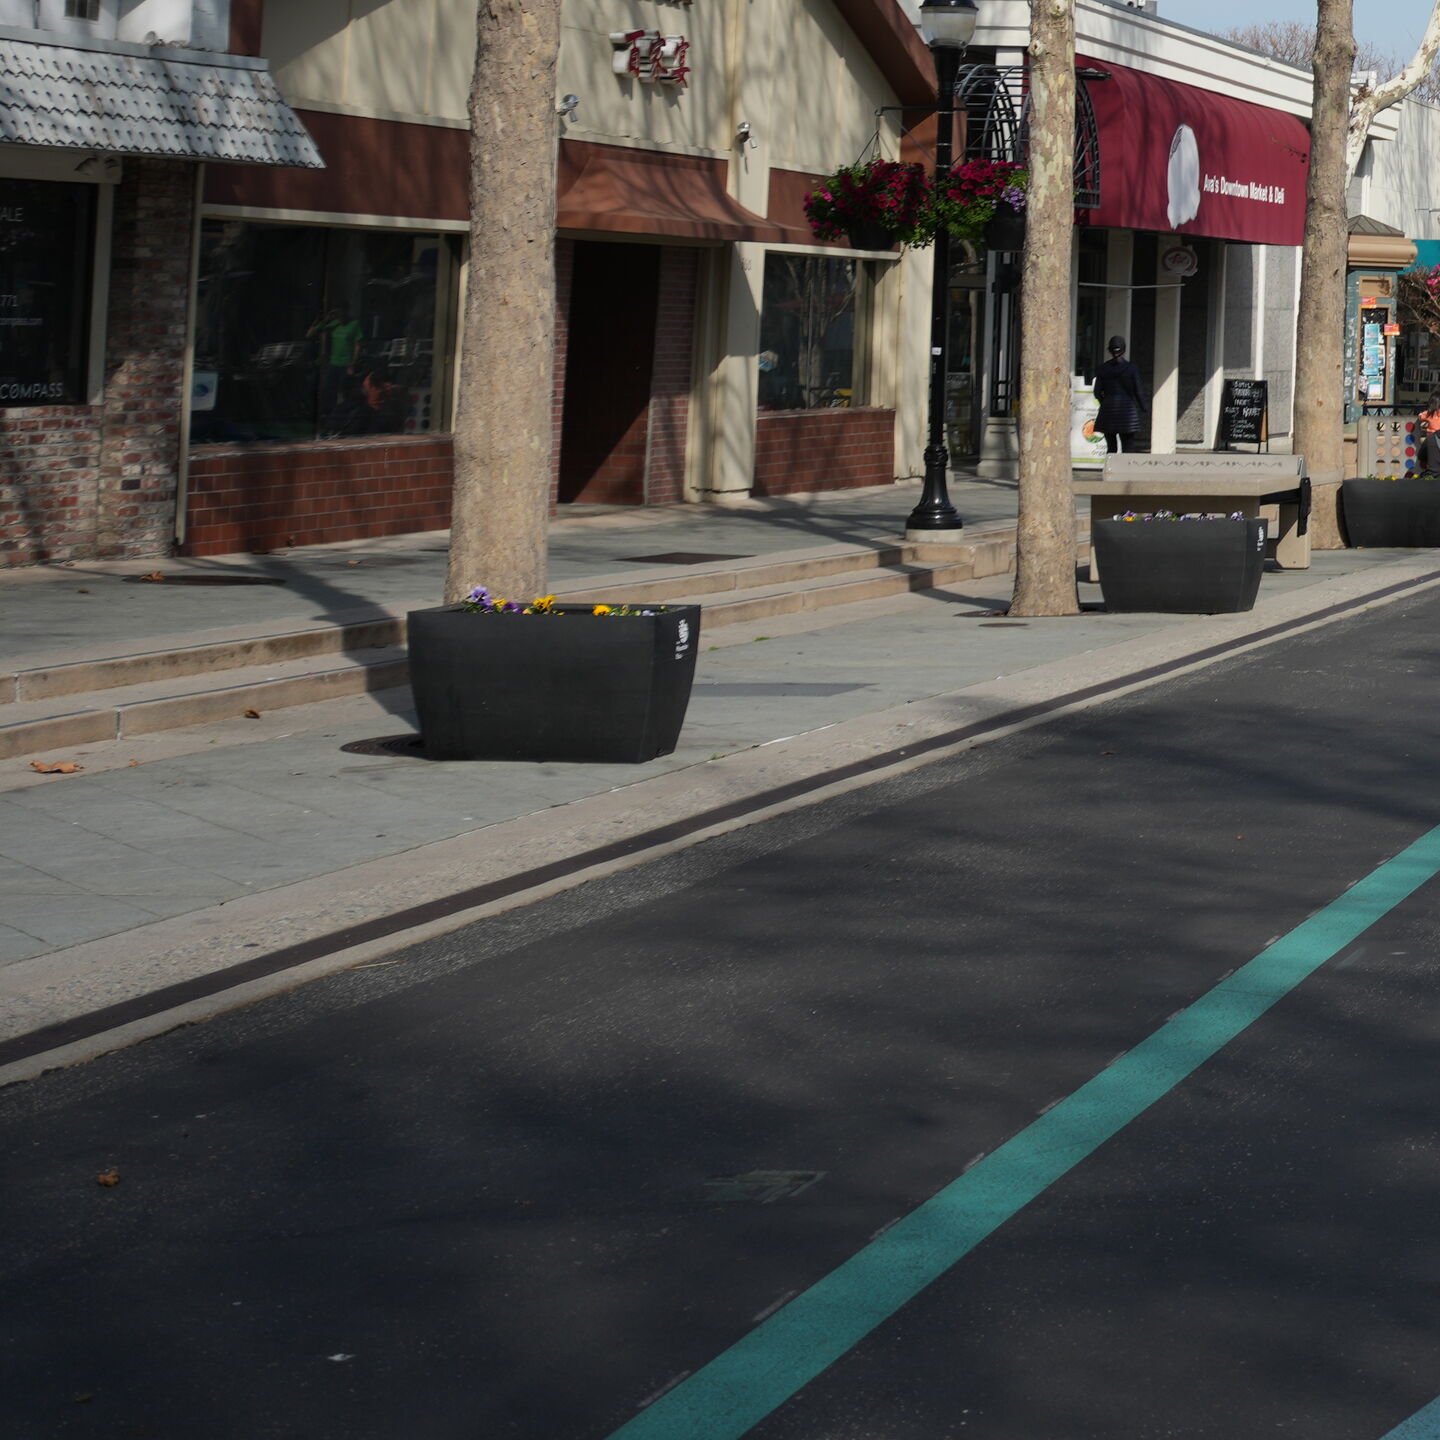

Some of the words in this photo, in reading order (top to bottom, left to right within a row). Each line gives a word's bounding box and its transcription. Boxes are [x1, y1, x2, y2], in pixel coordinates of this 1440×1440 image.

[1203, 173, 1219, 193] Ava's
[1220, 176, 1248, 198] Downtown
[1249, 181, 1267, 201] Market
[1268, 185, 1273, 203] &
[1274, 186, 1285, 204] Deli
